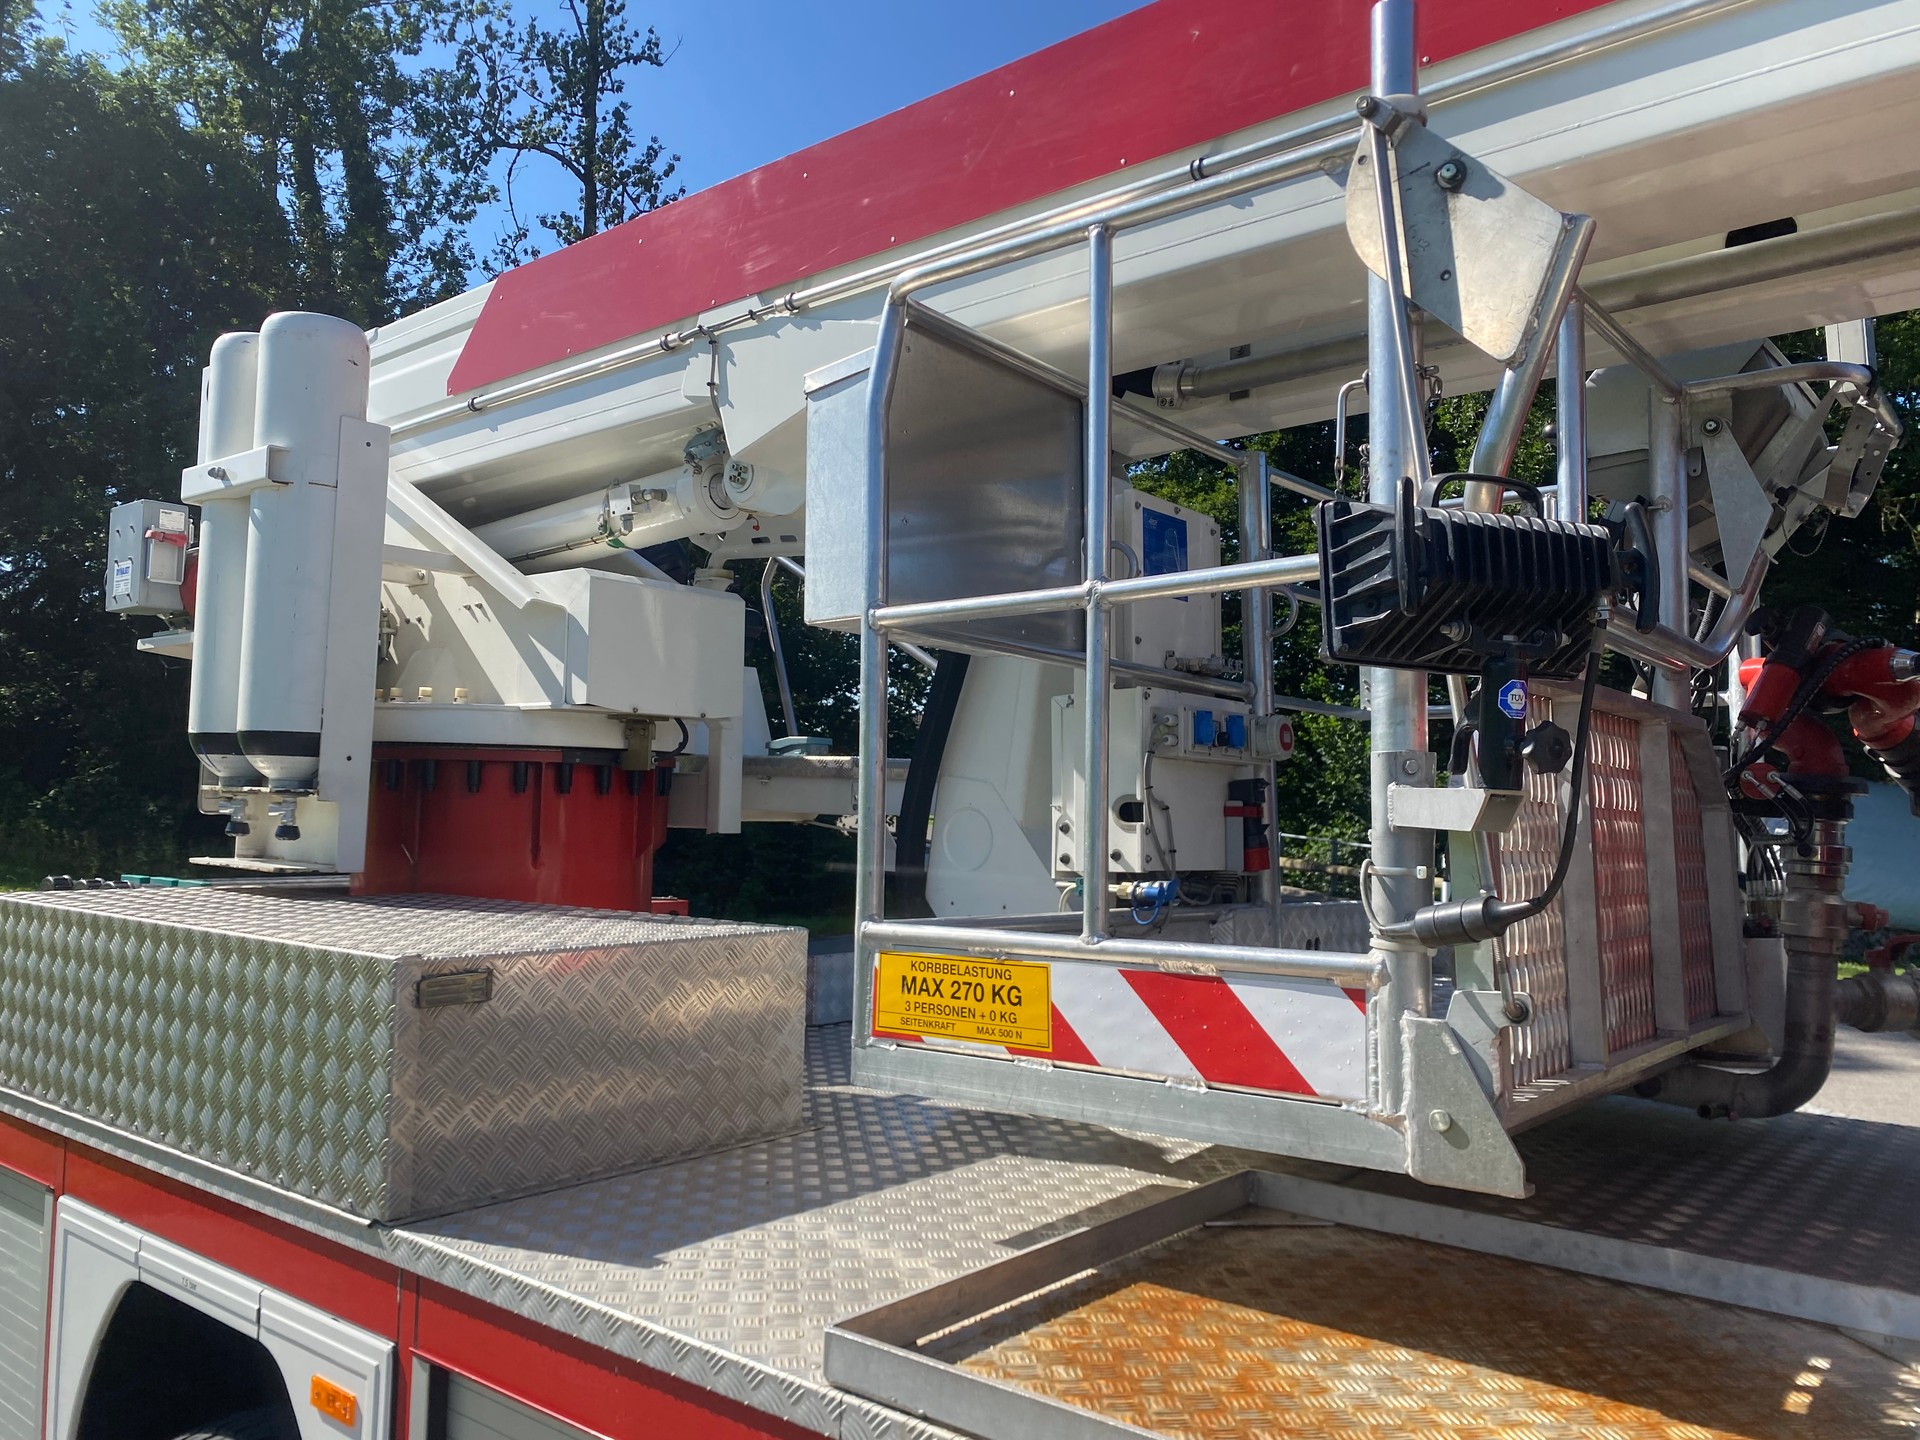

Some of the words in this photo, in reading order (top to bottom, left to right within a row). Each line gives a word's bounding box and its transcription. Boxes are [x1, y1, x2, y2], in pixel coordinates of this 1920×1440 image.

[910, 960, 1012, 980] KORBBELASTUNG
[902, 975, 944, 998] MAX
[950, 980, 985, 1003] 270
[992, 983, 1022, 1007] KG
[904, 1000, 911, 1012] 3
[914, 1001, 976, 1019] PERSONEN
[980, 1012, 986, 1020] +
[989, 1010, 996, 1022] 0
[1000, 1011, 1017, 1024] KG
[900, 1016, 956, 1031] SEITENKRAFT
[976, 1026, 996, 1037] MAX
[998, 1028, 1014, 1039] 500
[1016, 1030, 1022, 1040] N
